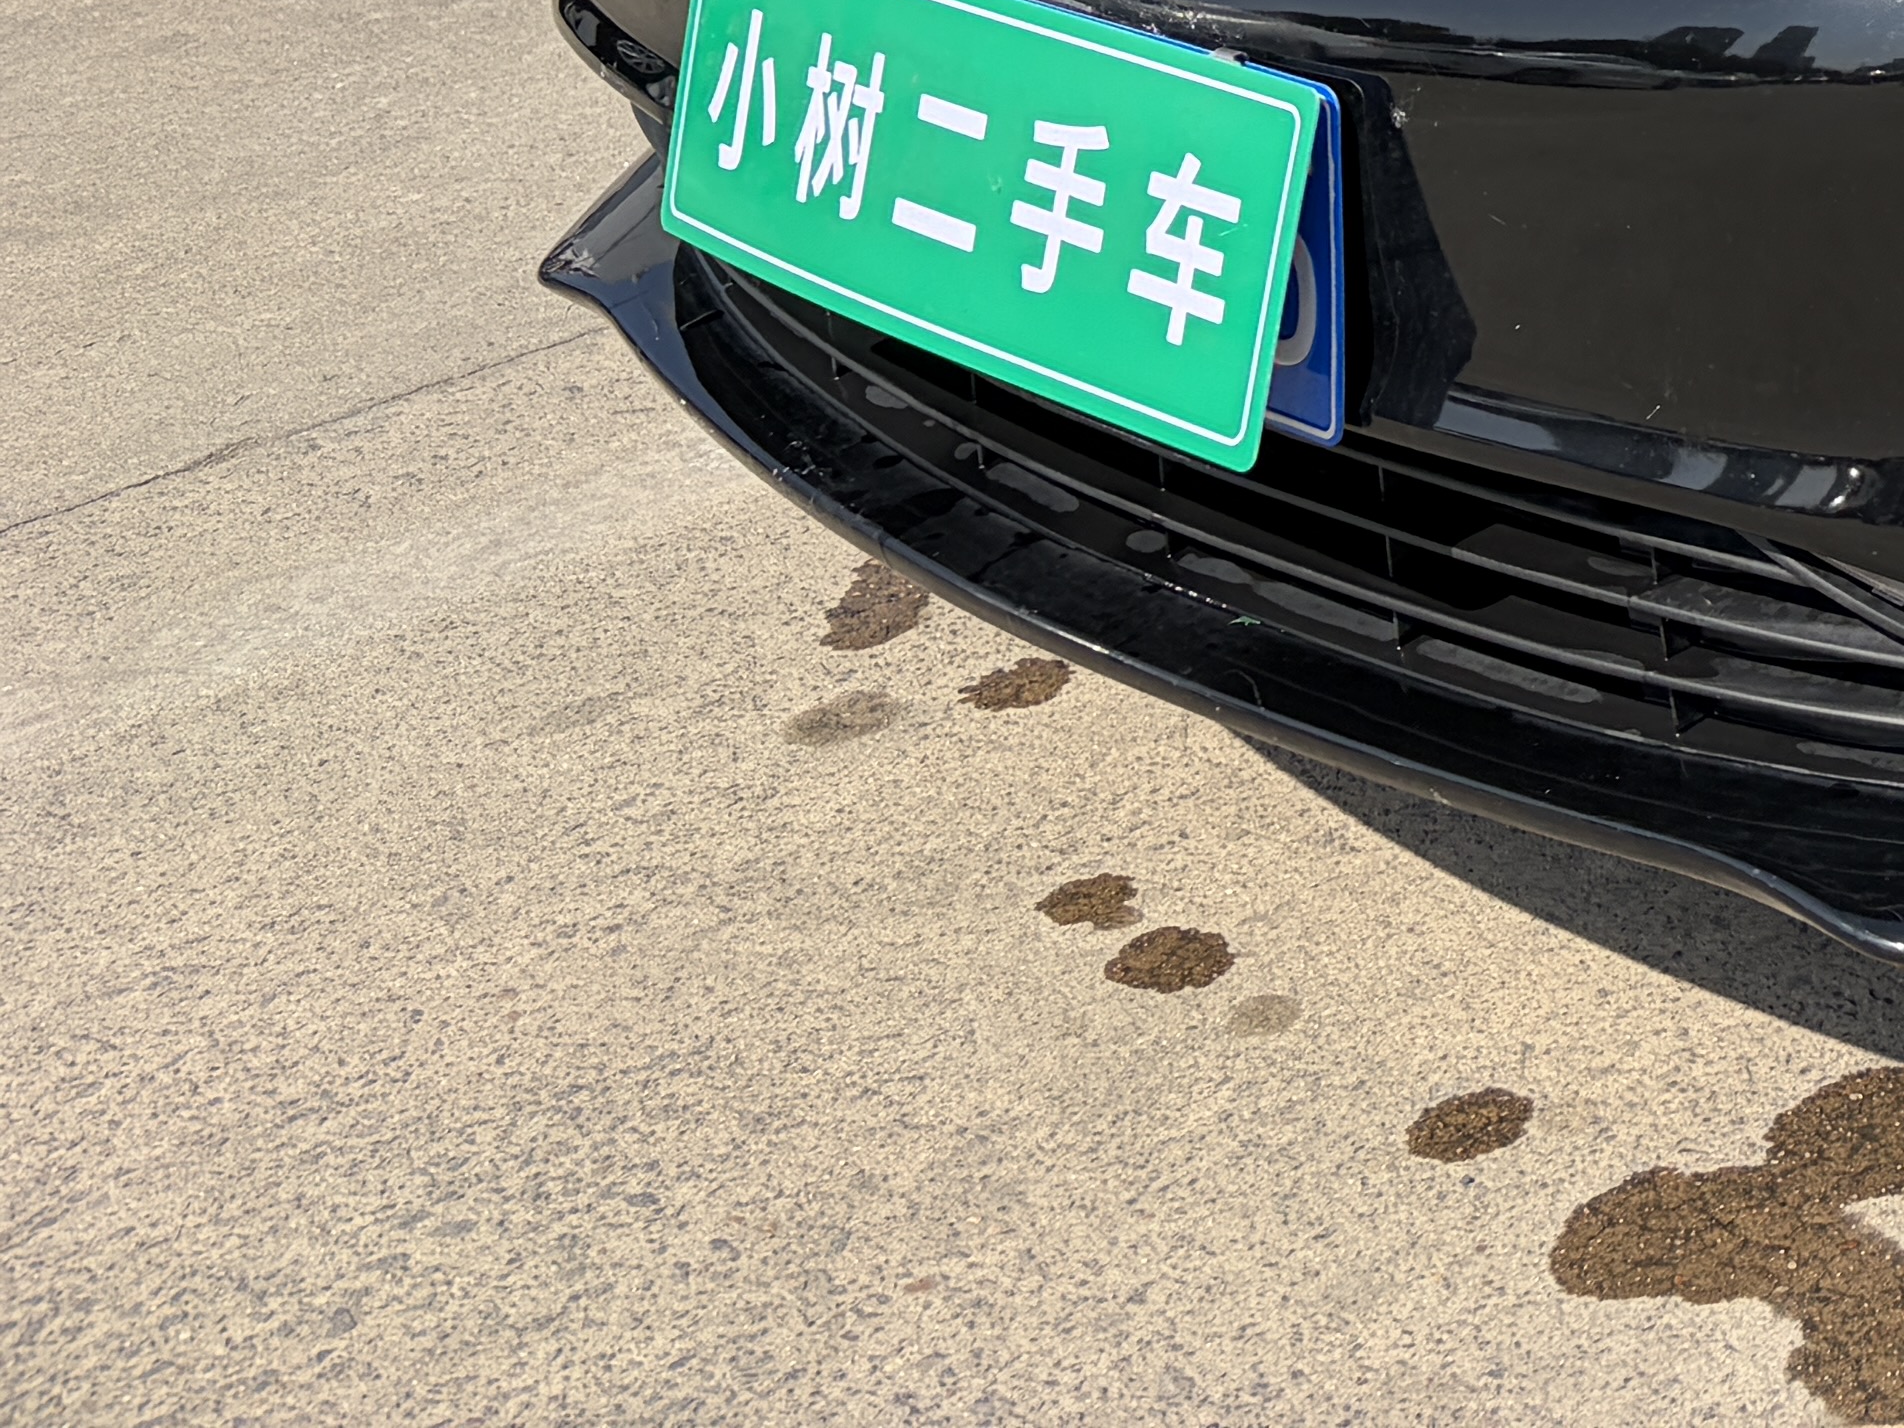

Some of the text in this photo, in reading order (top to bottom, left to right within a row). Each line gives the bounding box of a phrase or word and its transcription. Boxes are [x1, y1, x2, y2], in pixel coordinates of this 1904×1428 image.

[706, 7, 1244, 348] 小树二手车
